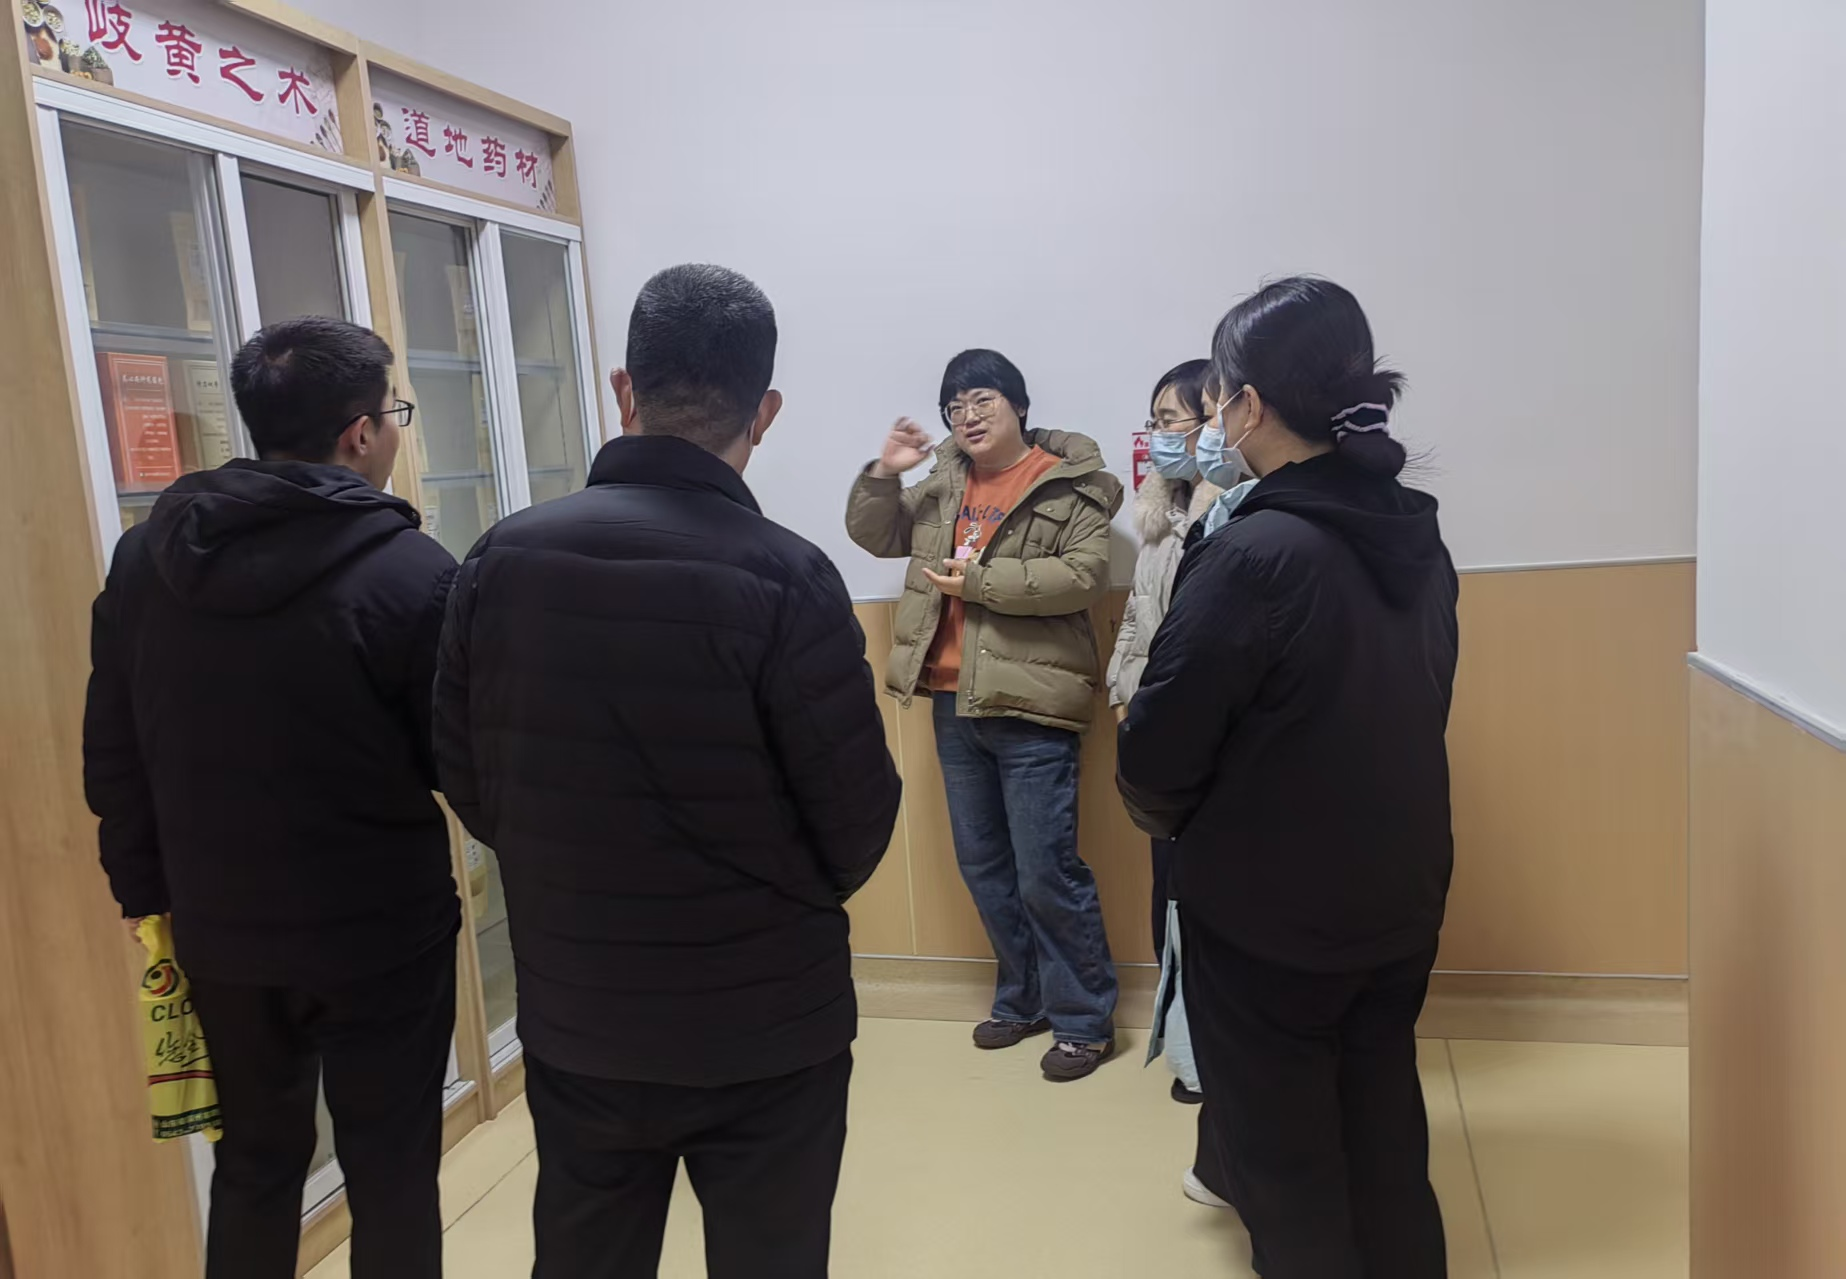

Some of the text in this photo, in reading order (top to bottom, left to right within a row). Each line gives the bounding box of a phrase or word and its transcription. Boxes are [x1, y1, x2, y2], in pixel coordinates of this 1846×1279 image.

[84, 0, 318, 115] 岐黄之术
[401, 107, 539, 189] 道地药材
